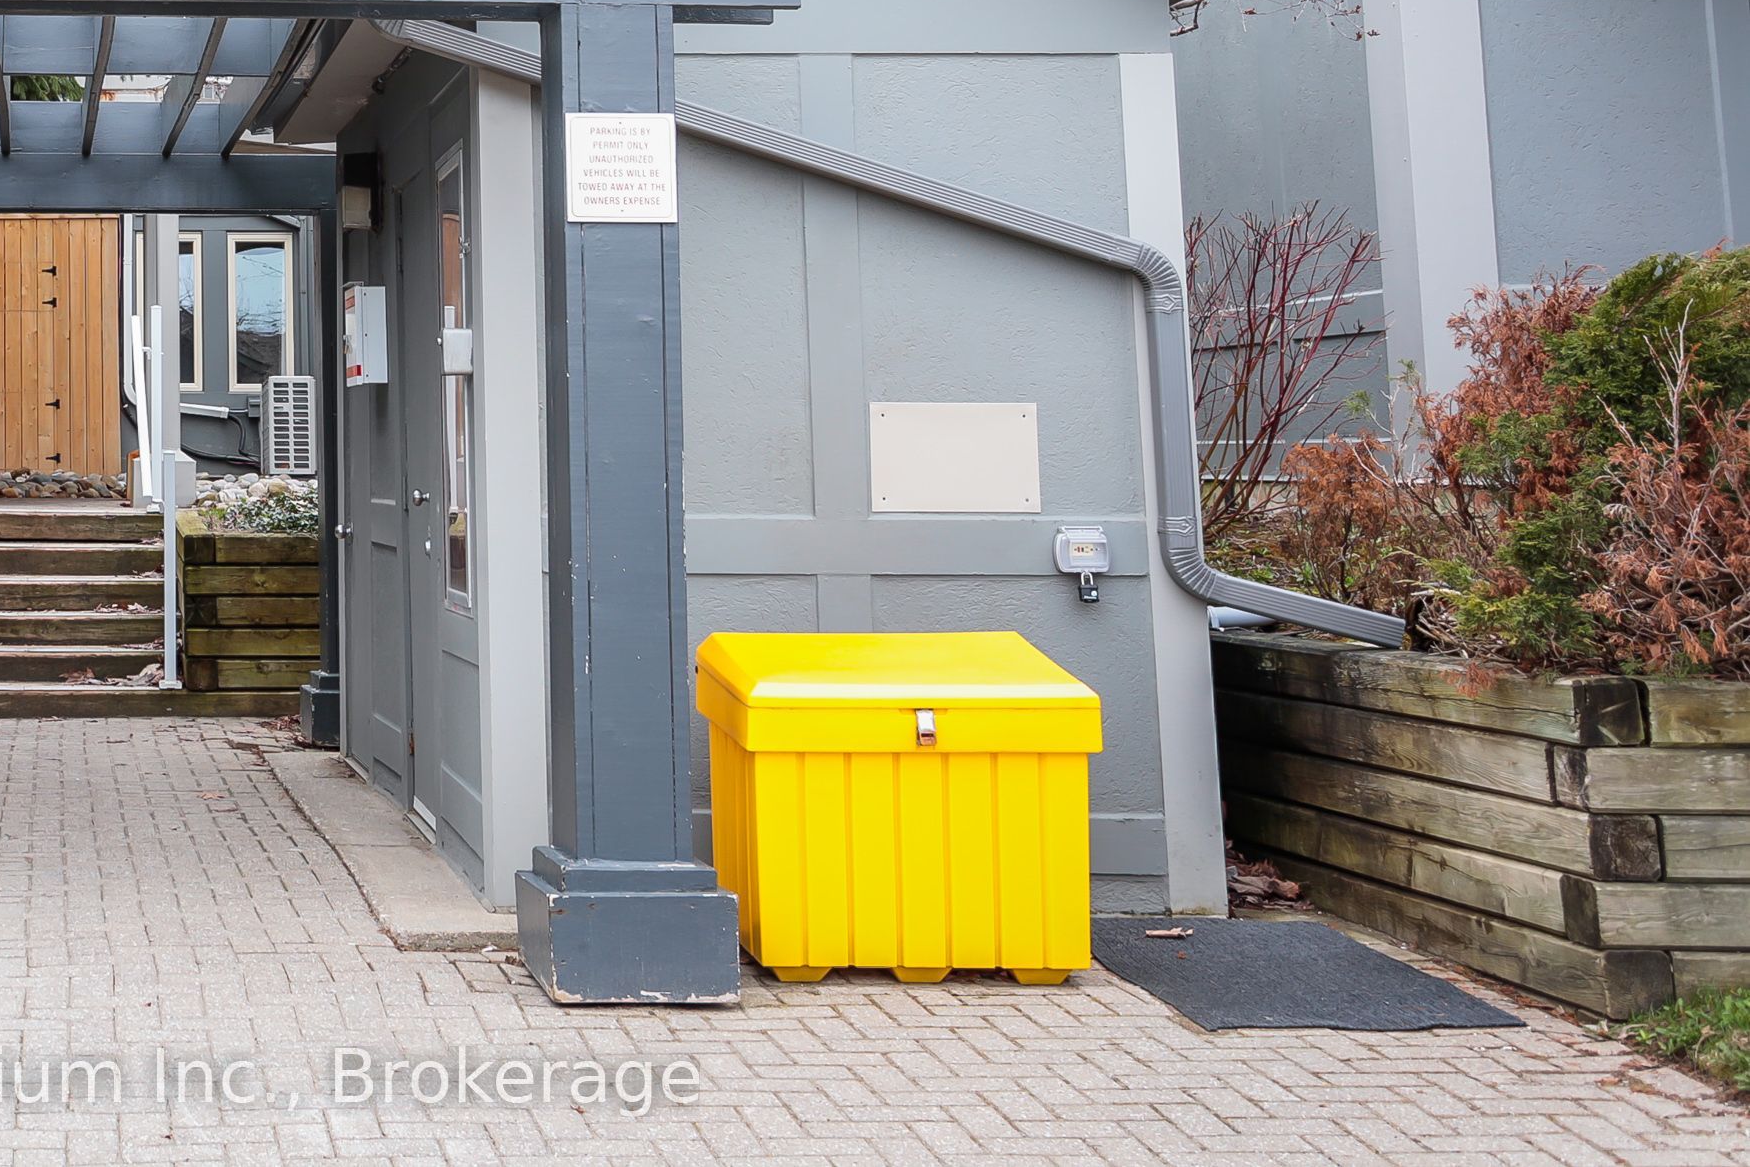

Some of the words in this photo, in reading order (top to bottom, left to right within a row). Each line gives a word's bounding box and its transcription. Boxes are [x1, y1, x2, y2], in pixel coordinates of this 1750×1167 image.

[590, 127, 627, 136] PARKING
[630, 127, 637, 136] IS
[641, 127, 651, 136] BY
[593, 141, 624, 150] PERMIT
[627, 141, 648, 150] ONLY
[589, 155, 654, 164] UNAUTHORIZED
[583, 169, 624, 178] VEHICLES
[626, 169, 647, 178] WILL
[650, 169, 659, 178] BE
[578, 183, 608, 192] TOWED
[611, 183, 634, 191] AWAY
[638, 183, 648, 191] AT
[651, 183, 666, 191] THE
[584, 197, 621, 206] OWNERS
[623, 197, 660, 206] EXPENSE
